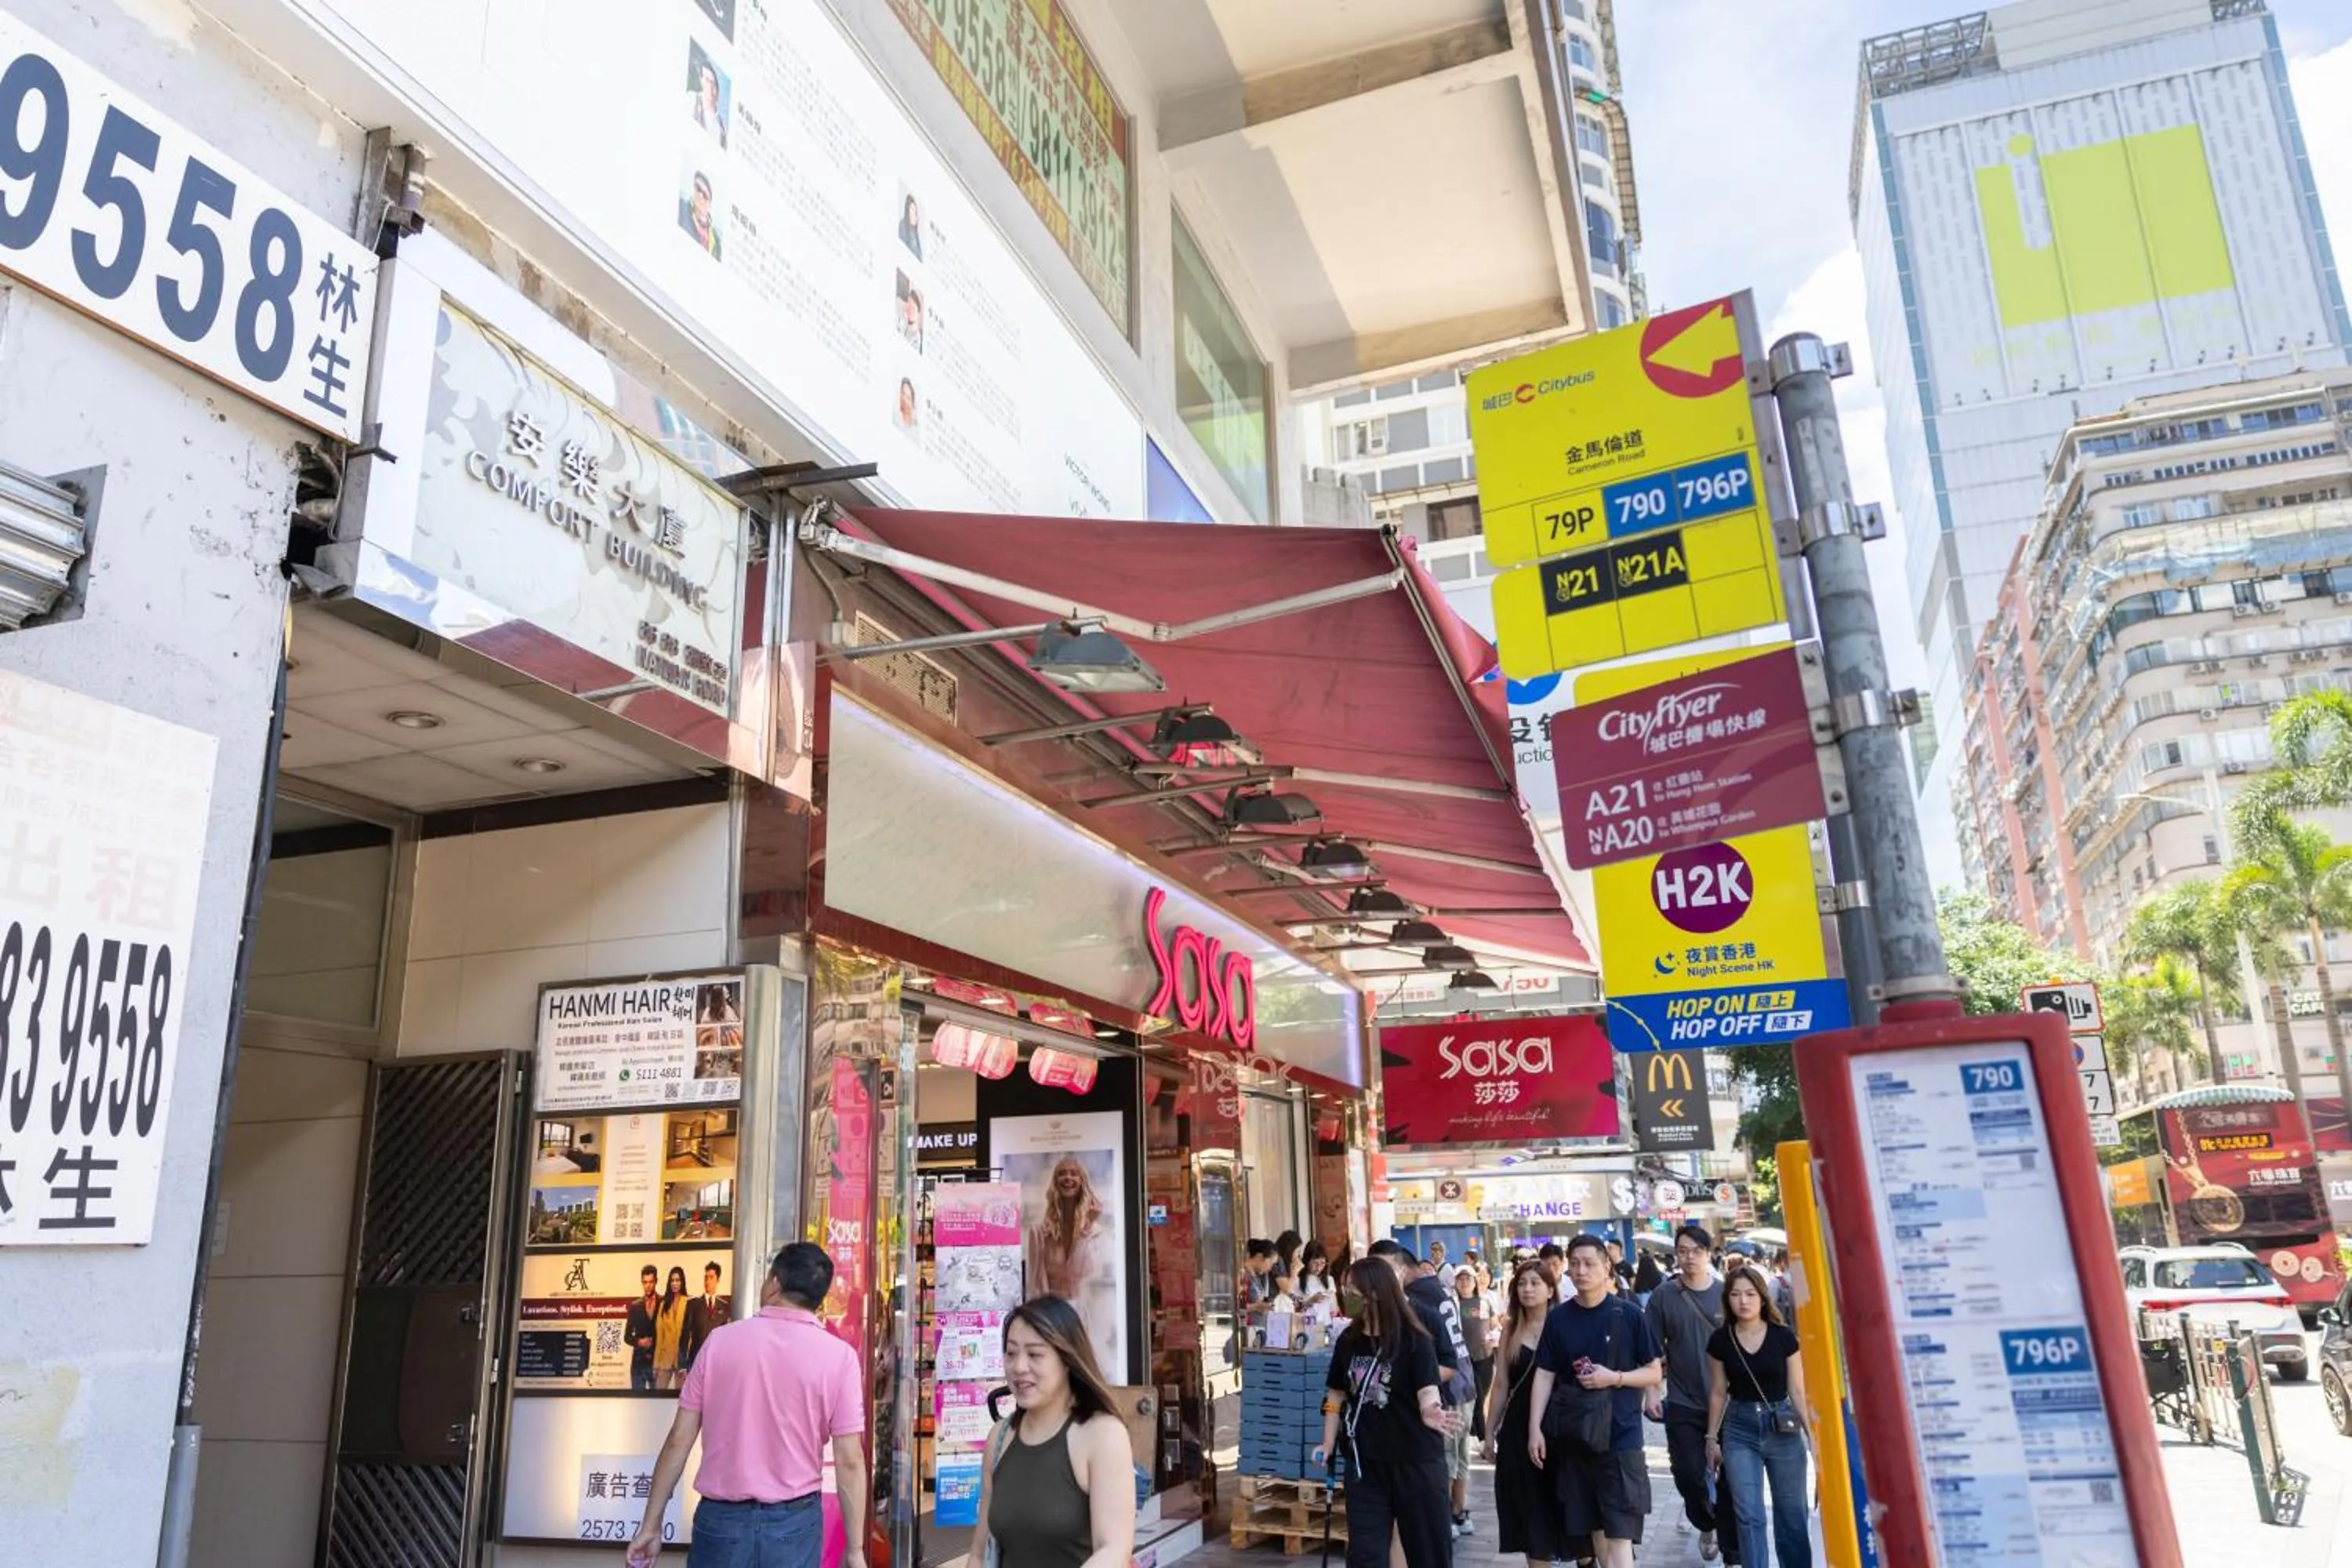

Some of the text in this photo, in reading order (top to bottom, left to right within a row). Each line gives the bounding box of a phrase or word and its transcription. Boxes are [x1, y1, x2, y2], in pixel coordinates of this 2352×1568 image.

[0, 52, 303, 383] 9558
[303, 252, 361, 419] 林生
[1537, 370, 1595, 395] Citybus
[1565, 428, 1644, 465] 金馬倫道
[1567, 448, 1646, 476] Cameron Road
[507, 409, 689, 559] 安樂大廈
[1544, 467, 1750, 540] 79P 790 796P
[465, 449, 710, 616] COMFORT BUILDING
[1649, 708, 1767, 754] 城巴機場快線
[1584, 779, 1648, 821] A21
[1655, 860, 1751, 911] H2K
[1685, 941, 1757, 964] 夜賞香港
[1686, 959, 1774, 979] Night Scene HK
[549, 988, 671, 1021] HANMI HAIR
[1666, 996, 1713, 1019] HOP
[1713, 993, 1746, 1015] ON
[51, 932, 172, 1138] 9558
[1670, 1018, 1717, 1040] HOP
[1719, 1014, 1763, 1036] OFF
[1473, 1080, 1521, 1105] 莎莎
[1969, 1065, 2014, 1090] 790
[907, 1132, 978, 1149] MAKE UP
[2008, 1336, 2080, 1366] 796P
[580, 1519, 675, 1541] 2573 70
